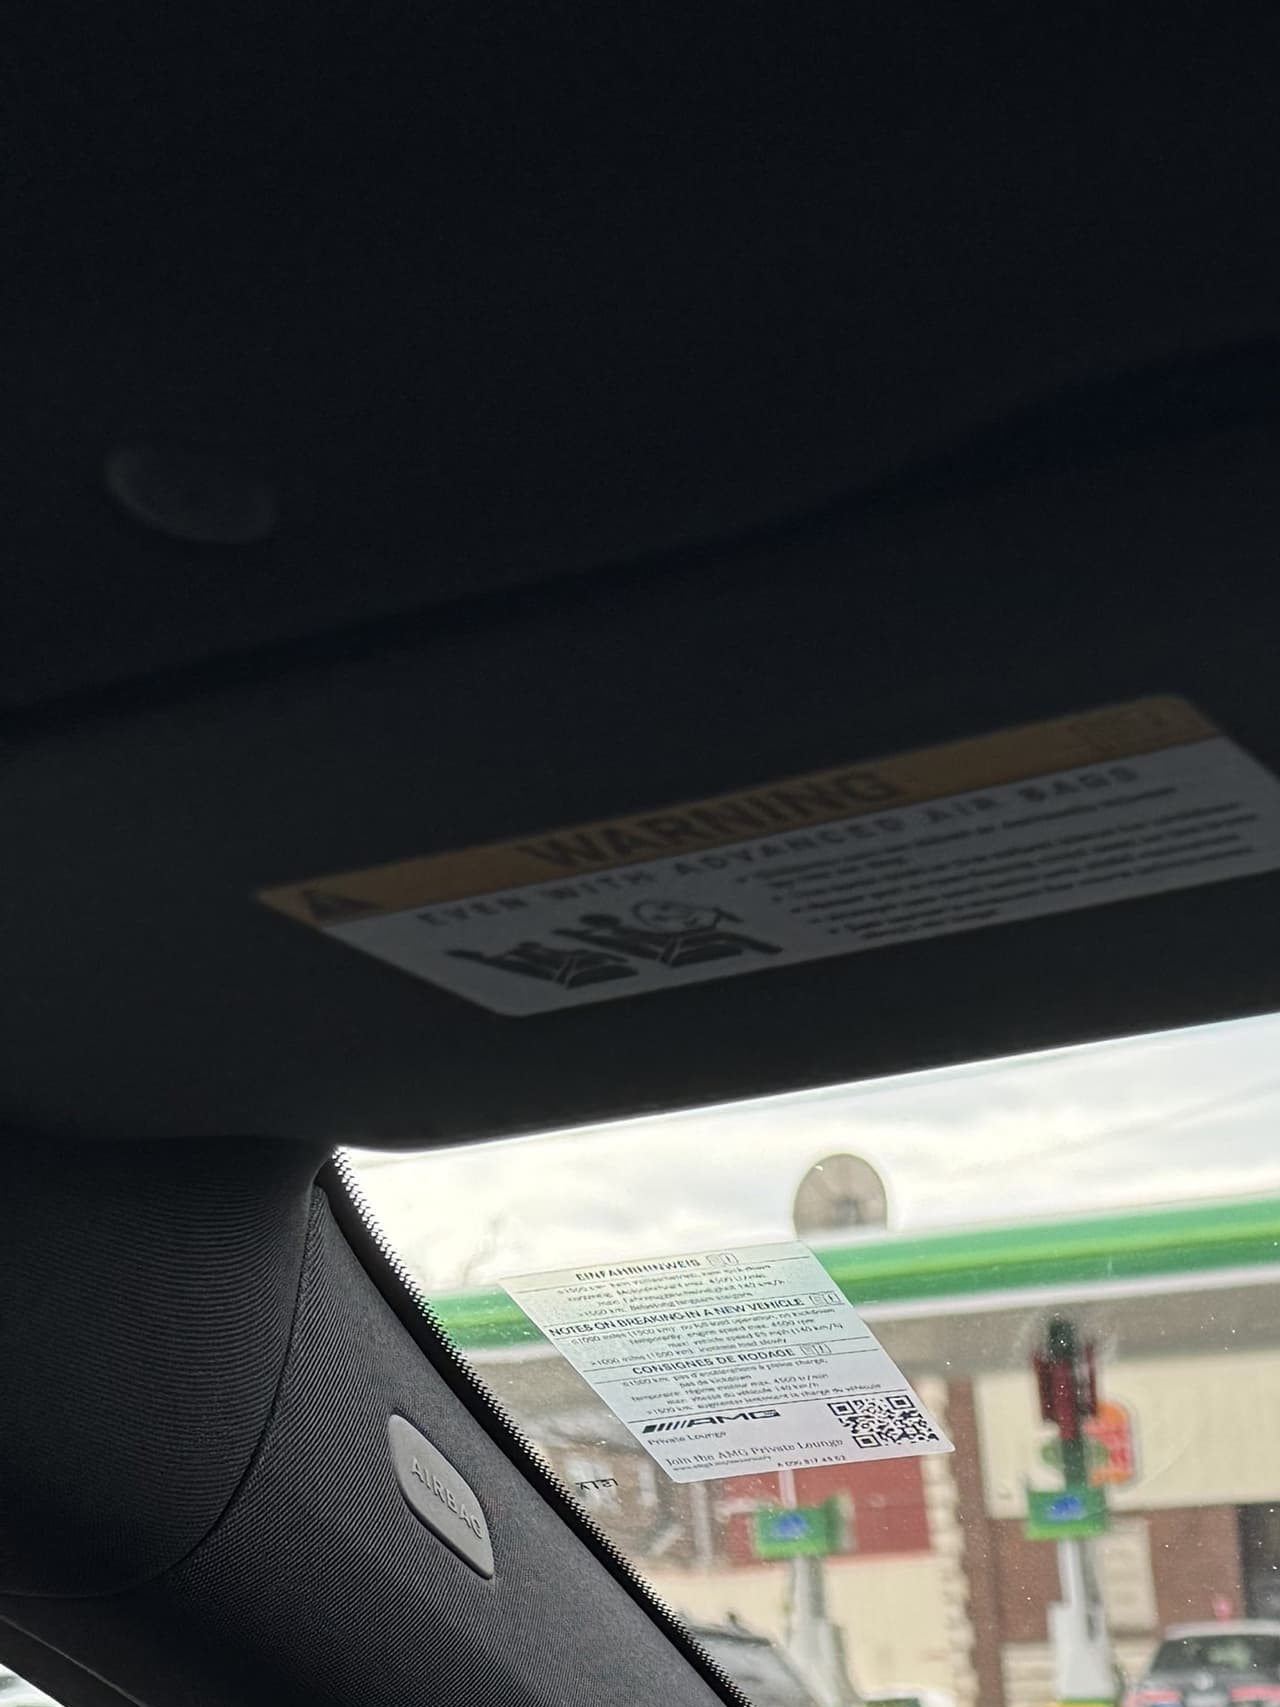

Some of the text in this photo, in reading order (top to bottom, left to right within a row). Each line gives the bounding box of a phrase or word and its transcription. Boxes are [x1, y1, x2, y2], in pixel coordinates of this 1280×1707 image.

[525, 770, 905, 868] WARNING
[681, 1408, 782, 1428] AMG
[411, 1457, 484, 1539] AIRBAG
